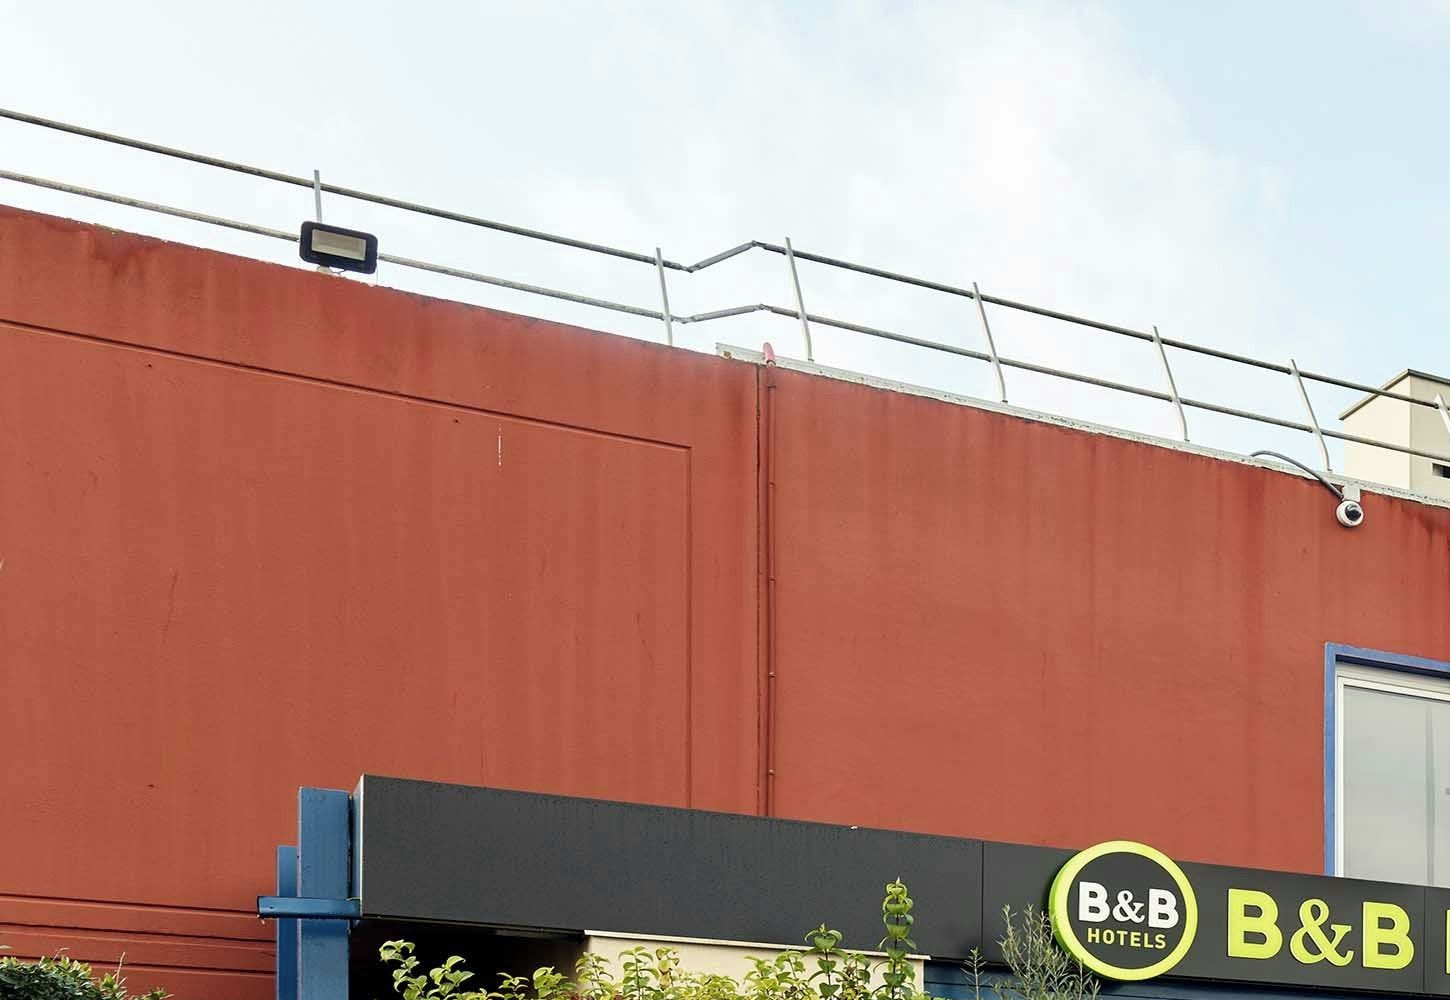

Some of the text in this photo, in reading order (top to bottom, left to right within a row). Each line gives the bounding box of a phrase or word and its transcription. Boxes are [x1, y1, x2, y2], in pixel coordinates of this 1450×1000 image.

[1078, 881, 1179, 929] B&B
[1227, 887, 1416, 970] B&B
[1087, 927, 1167, 950] HOTELS
